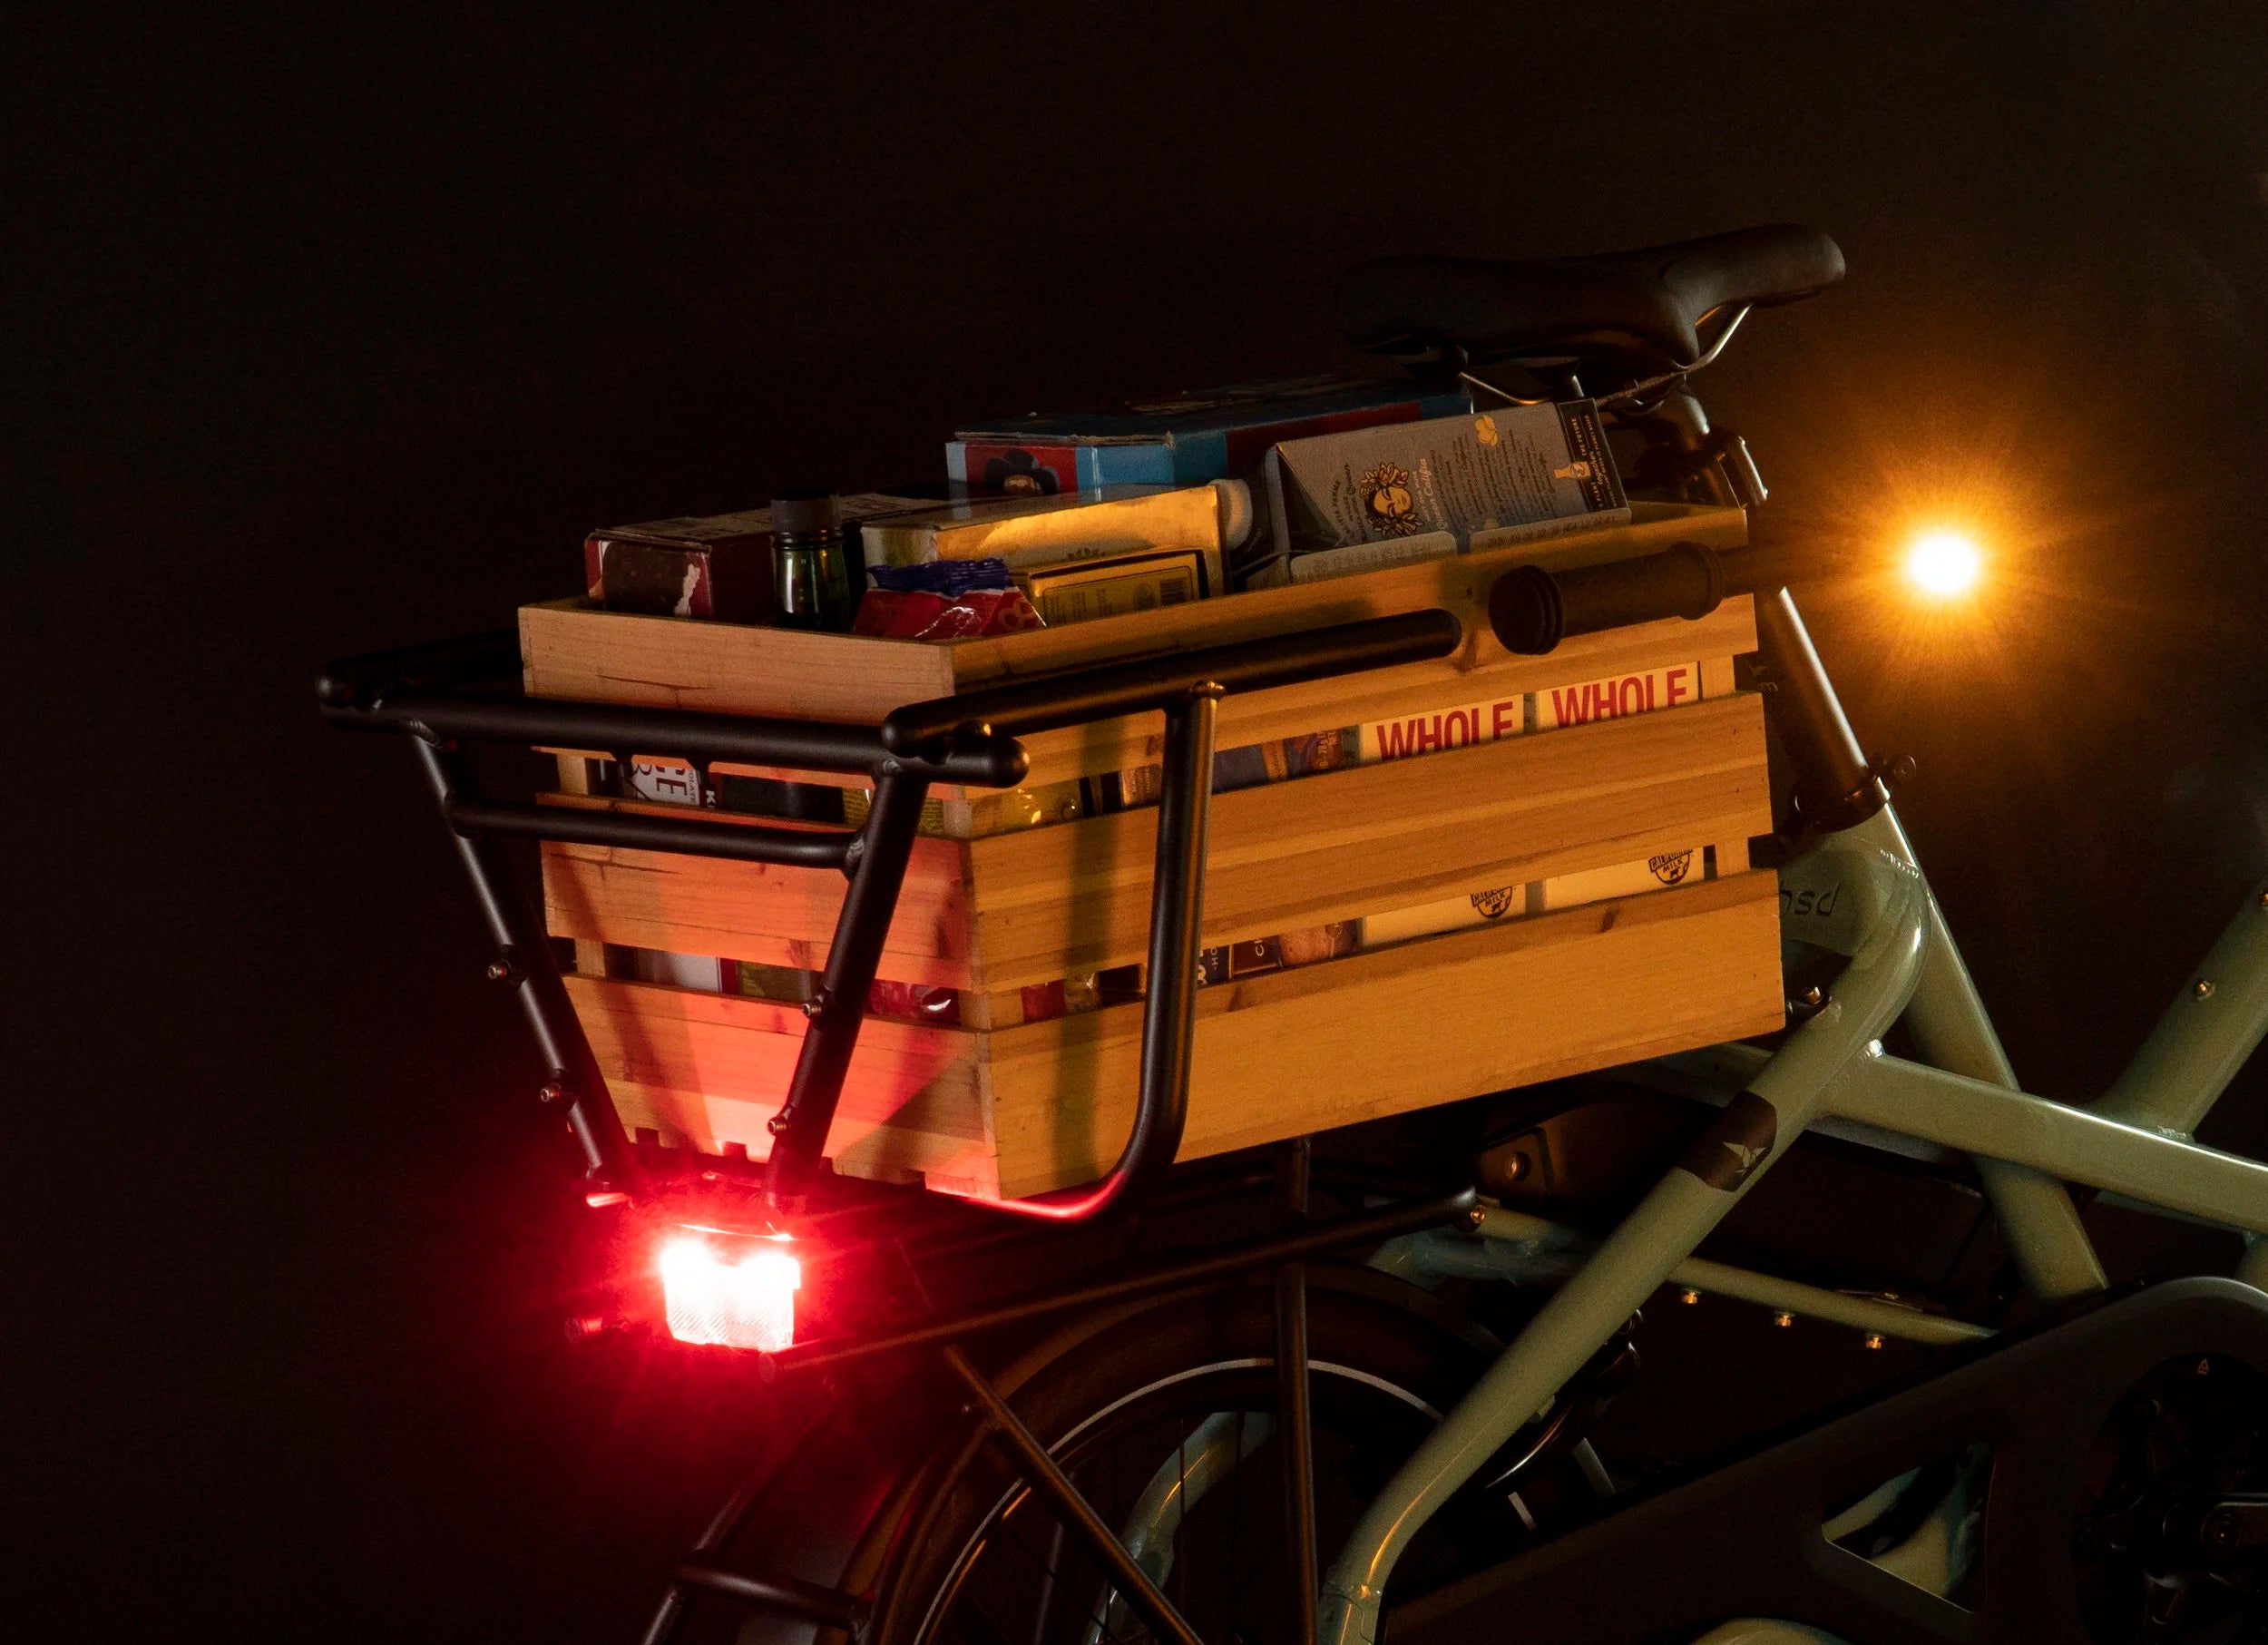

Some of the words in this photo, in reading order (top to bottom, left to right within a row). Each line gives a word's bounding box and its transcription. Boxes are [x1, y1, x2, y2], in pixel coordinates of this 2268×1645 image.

[1551, 669, 1687, 729] WHOLE
[1376, 701, 1513, 760] WHOLE
[1663, 857, 1683, 873] MILK
[1484, 891, 1506, 907] MILK
